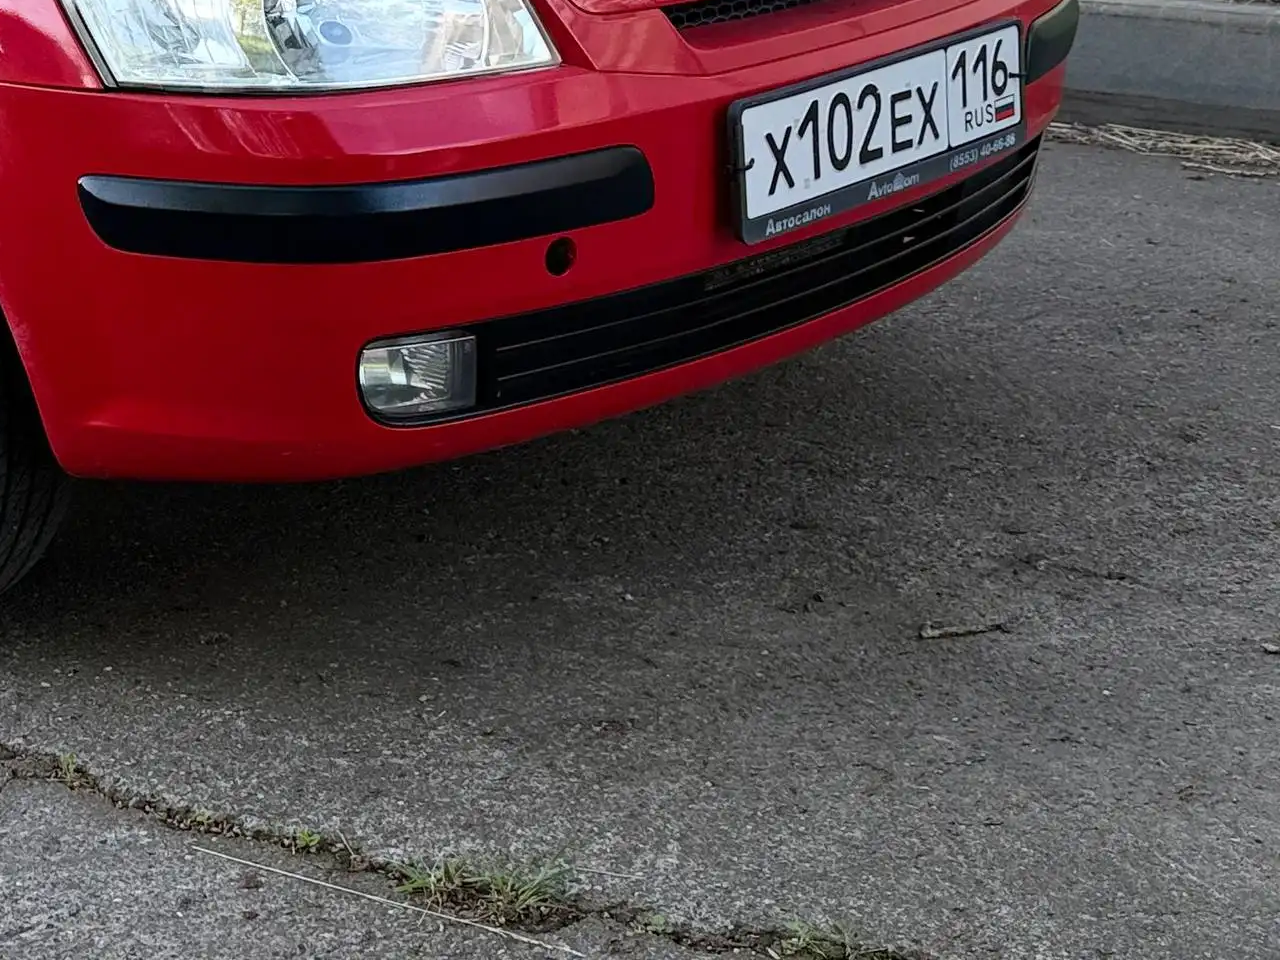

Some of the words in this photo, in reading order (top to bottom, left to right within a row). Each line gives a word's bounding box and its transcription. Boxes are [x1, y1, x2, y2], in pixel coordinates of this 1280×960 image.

[952, 38, 1008, 109] 116
[964, 103, 994, 132] RUS
[949, 147, 979, 172] (8553)
[765, 203, 831, 236] Автосалон
